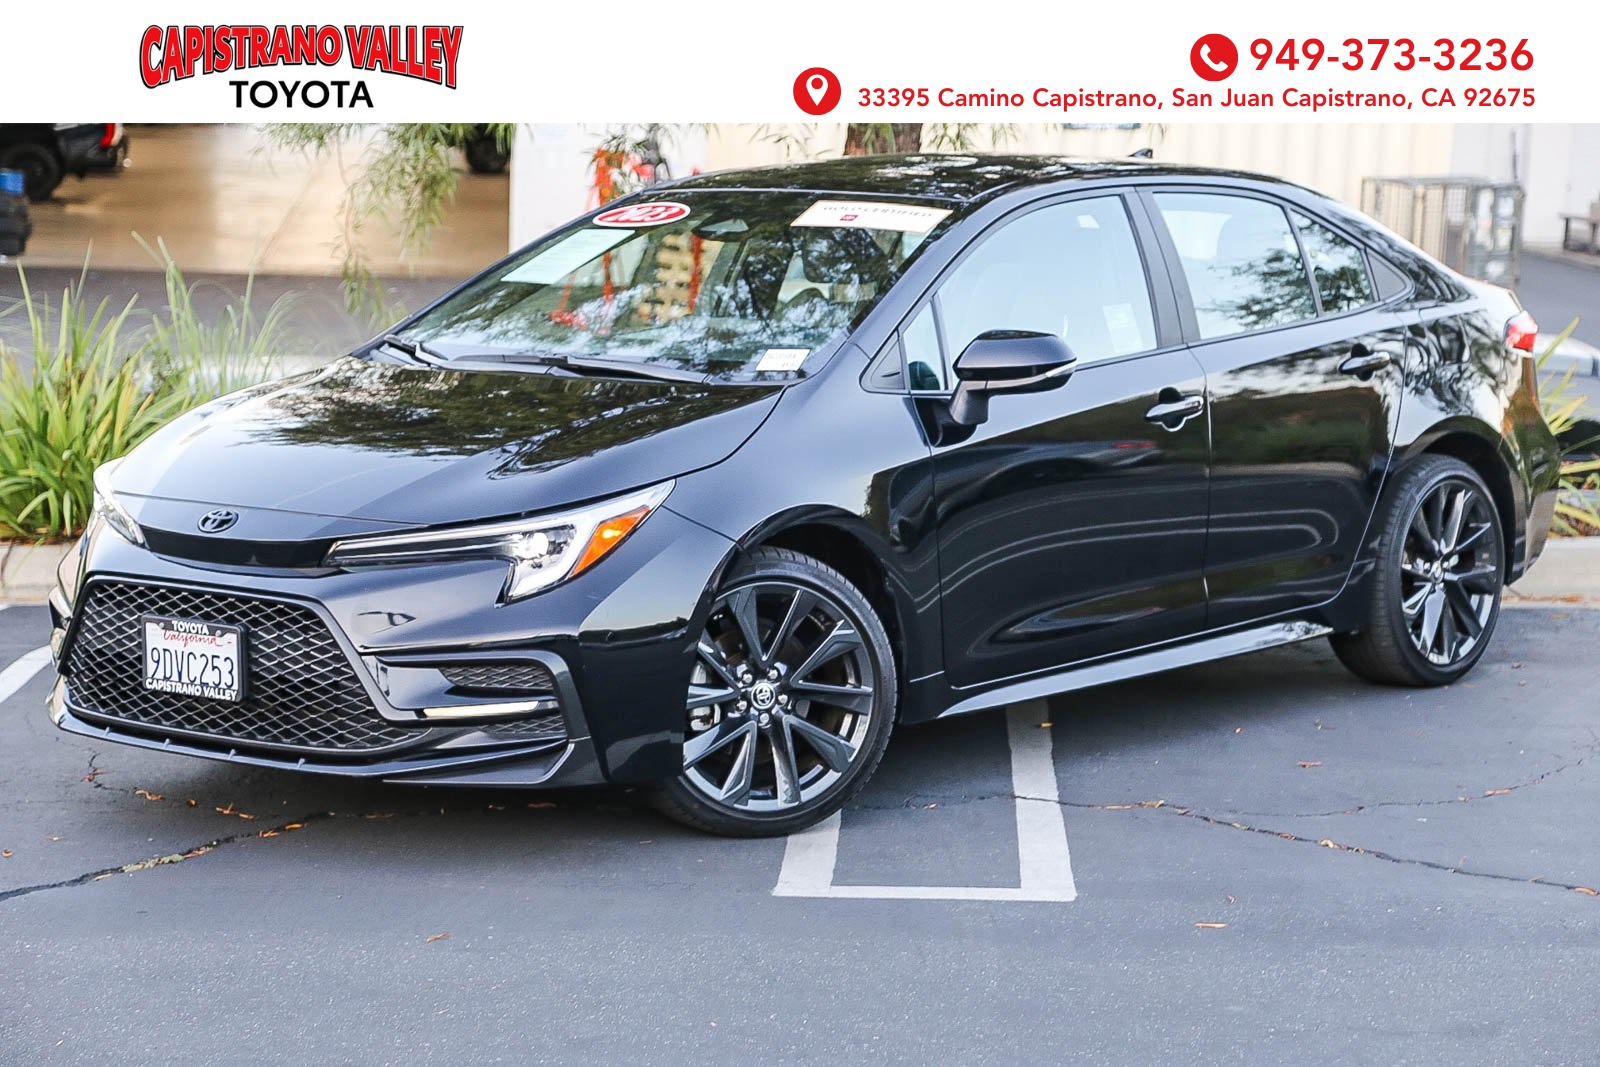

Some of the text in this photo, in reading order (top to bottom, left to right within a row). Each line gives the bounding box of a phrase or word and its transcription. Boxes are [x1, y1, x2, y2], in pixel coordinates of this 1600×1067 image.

[172, 621, 209, 635] TOYOTA
[163, 630, 223, 647] California
[151, 647, 234, 688] 9DVC253
[146, 679, 238, 701] CAPISTRANO VALLEY
